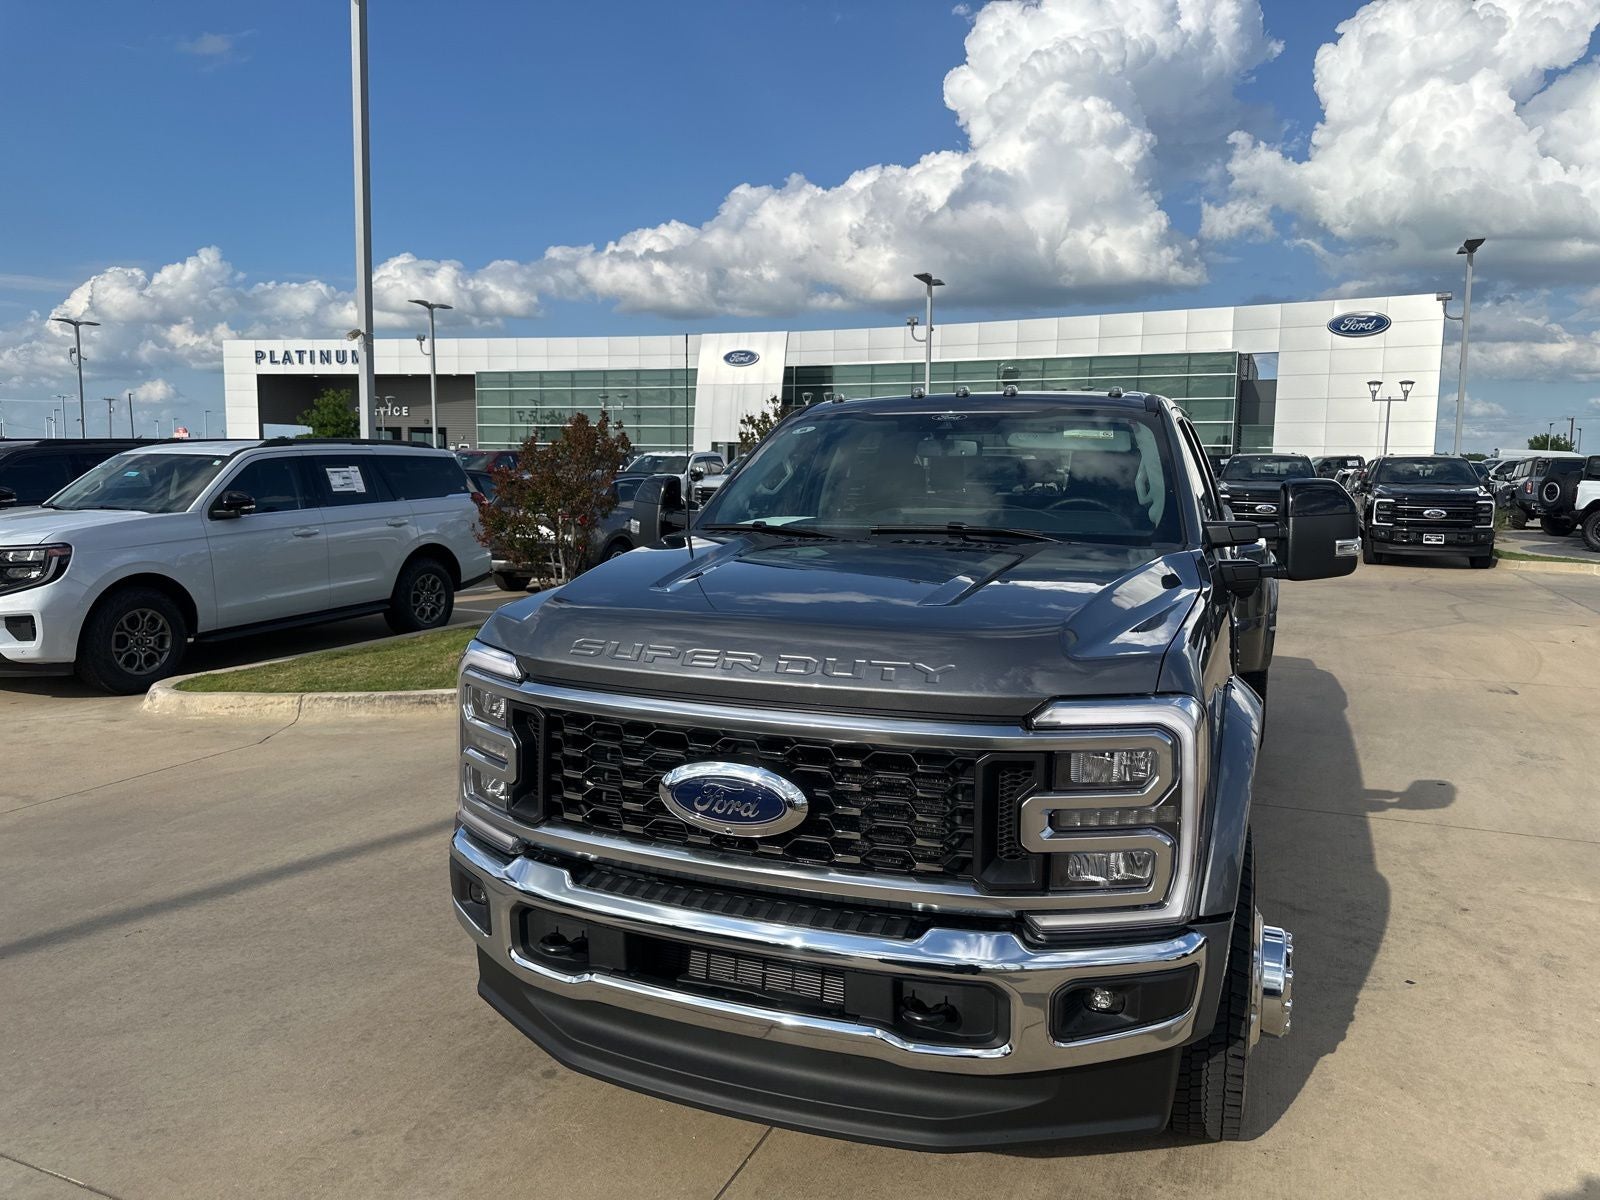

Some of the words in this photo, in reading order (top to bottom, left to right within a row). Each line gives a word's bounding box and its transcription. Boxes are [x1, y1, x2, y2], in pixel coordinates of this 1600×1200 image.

[1340, 316, 1376, 331] Ford
[569, 638, 763, 673] SUPER
[775, 654, 956, 684] DUTY
[693, 782, 762, 818] Ford
